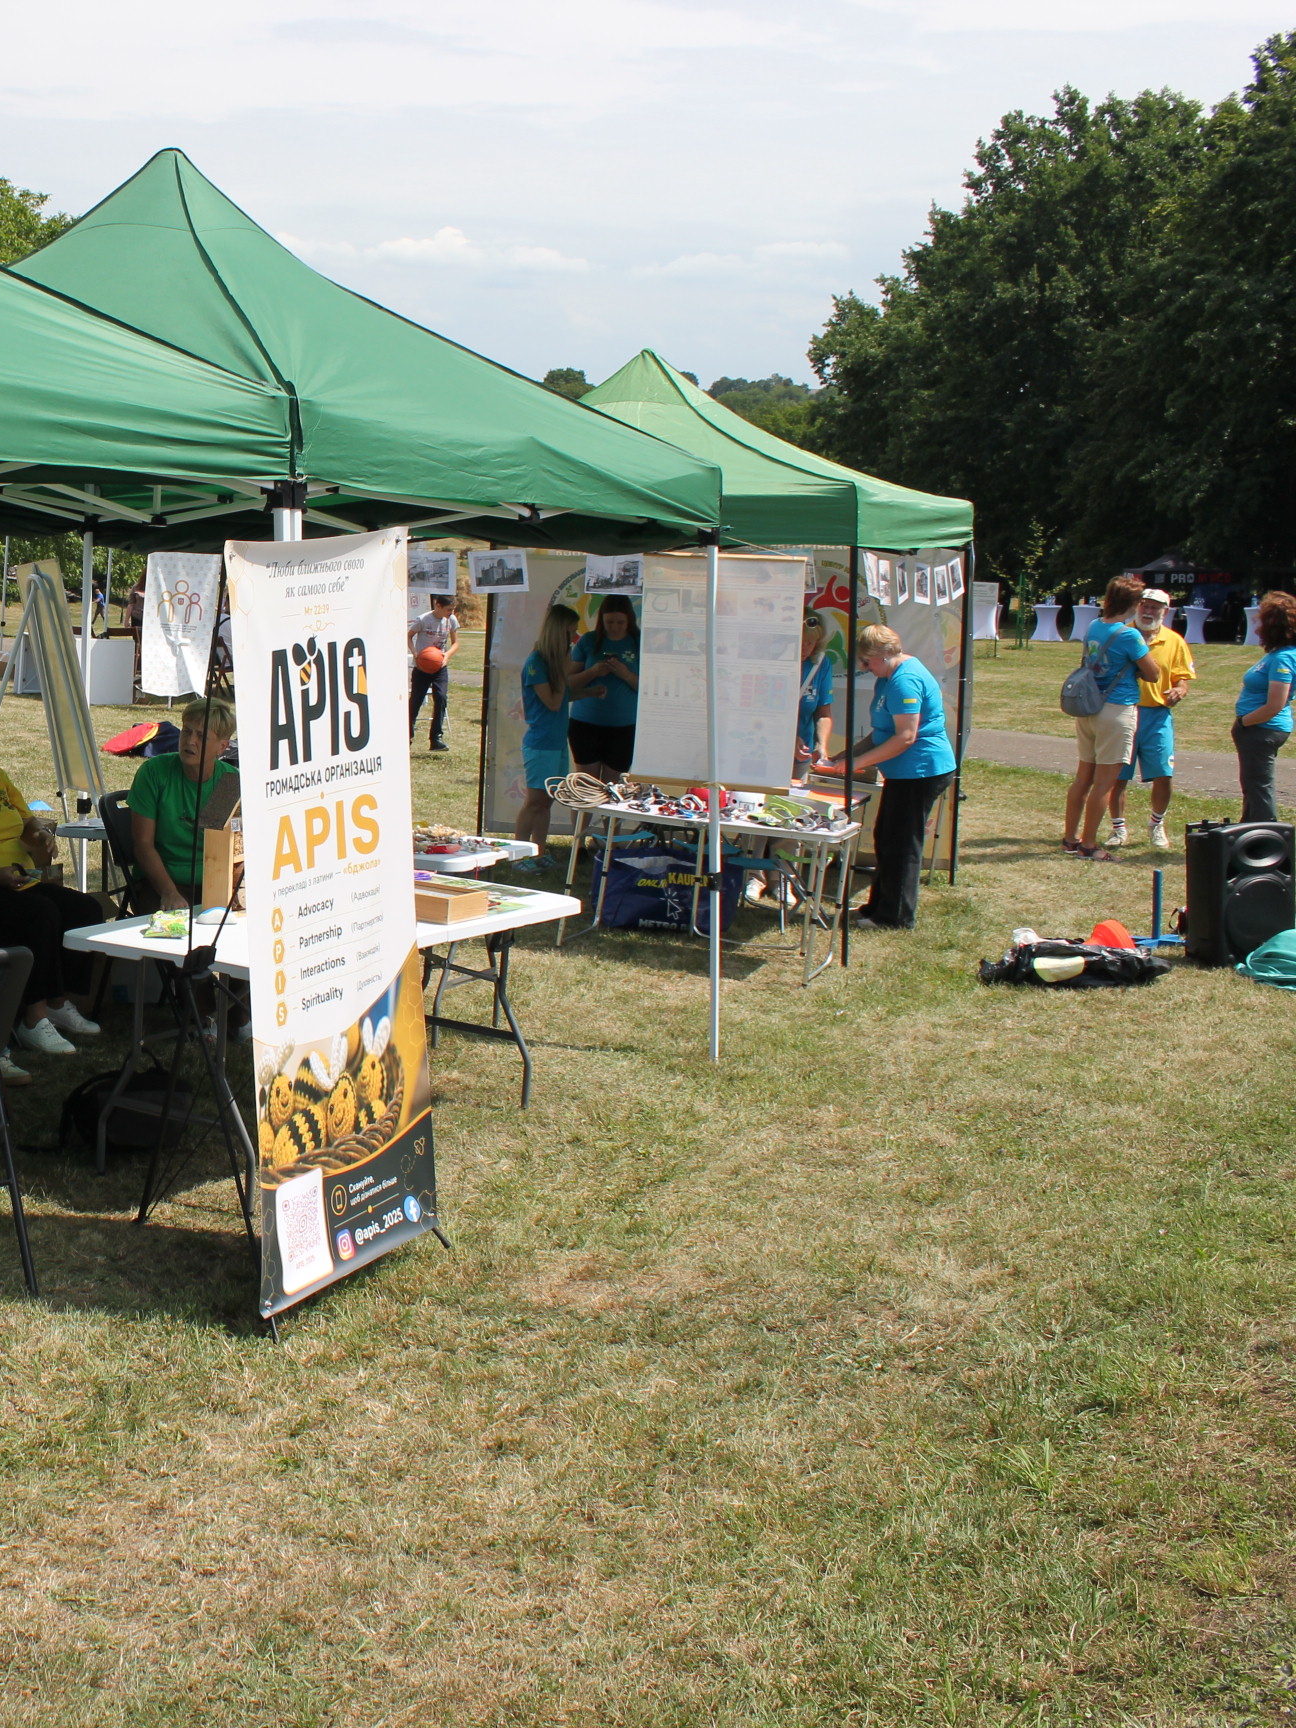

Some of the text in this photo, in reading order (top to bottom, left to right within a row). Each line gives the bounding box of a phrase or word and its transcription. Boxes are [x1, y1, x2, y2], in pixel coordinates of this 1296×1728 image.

[298, 559, 342, 575] ближнього
[344, 558, 365, 570] свого
[1170, 574, 1194, 584] PRO
[285, 586, 295, 598] як
[298, 583, 326, 597] самого
[314, 604, 329, 615] 22:39
[270, 637, 370, 770] APIS
[266, 756, 382, 798] ГРОМАДСЬКА ОРГАНІЗАЦІЯ
[272, 794, 380, 880] APIS
[273, 891, 277, 900] у
[278, 880, 307, 897] перекладі
[313, 872, 333, 885] латини
[343, 858, 380, 876] «бджола»
[273, 916, 280, 929] A
[298, 897, 334, 919] Advocacy
[639, 919, 677, 928] METRO
[275, 944, 281, 960] P
[300, 925, 342, 949] Partnership
[300, 955, 345, 980] Interactions
[278, 1007, 285, 1022] S
[302, 987, 343, 1011] Spirituality
[355, 1207, 403, 1245] @apis_2025
